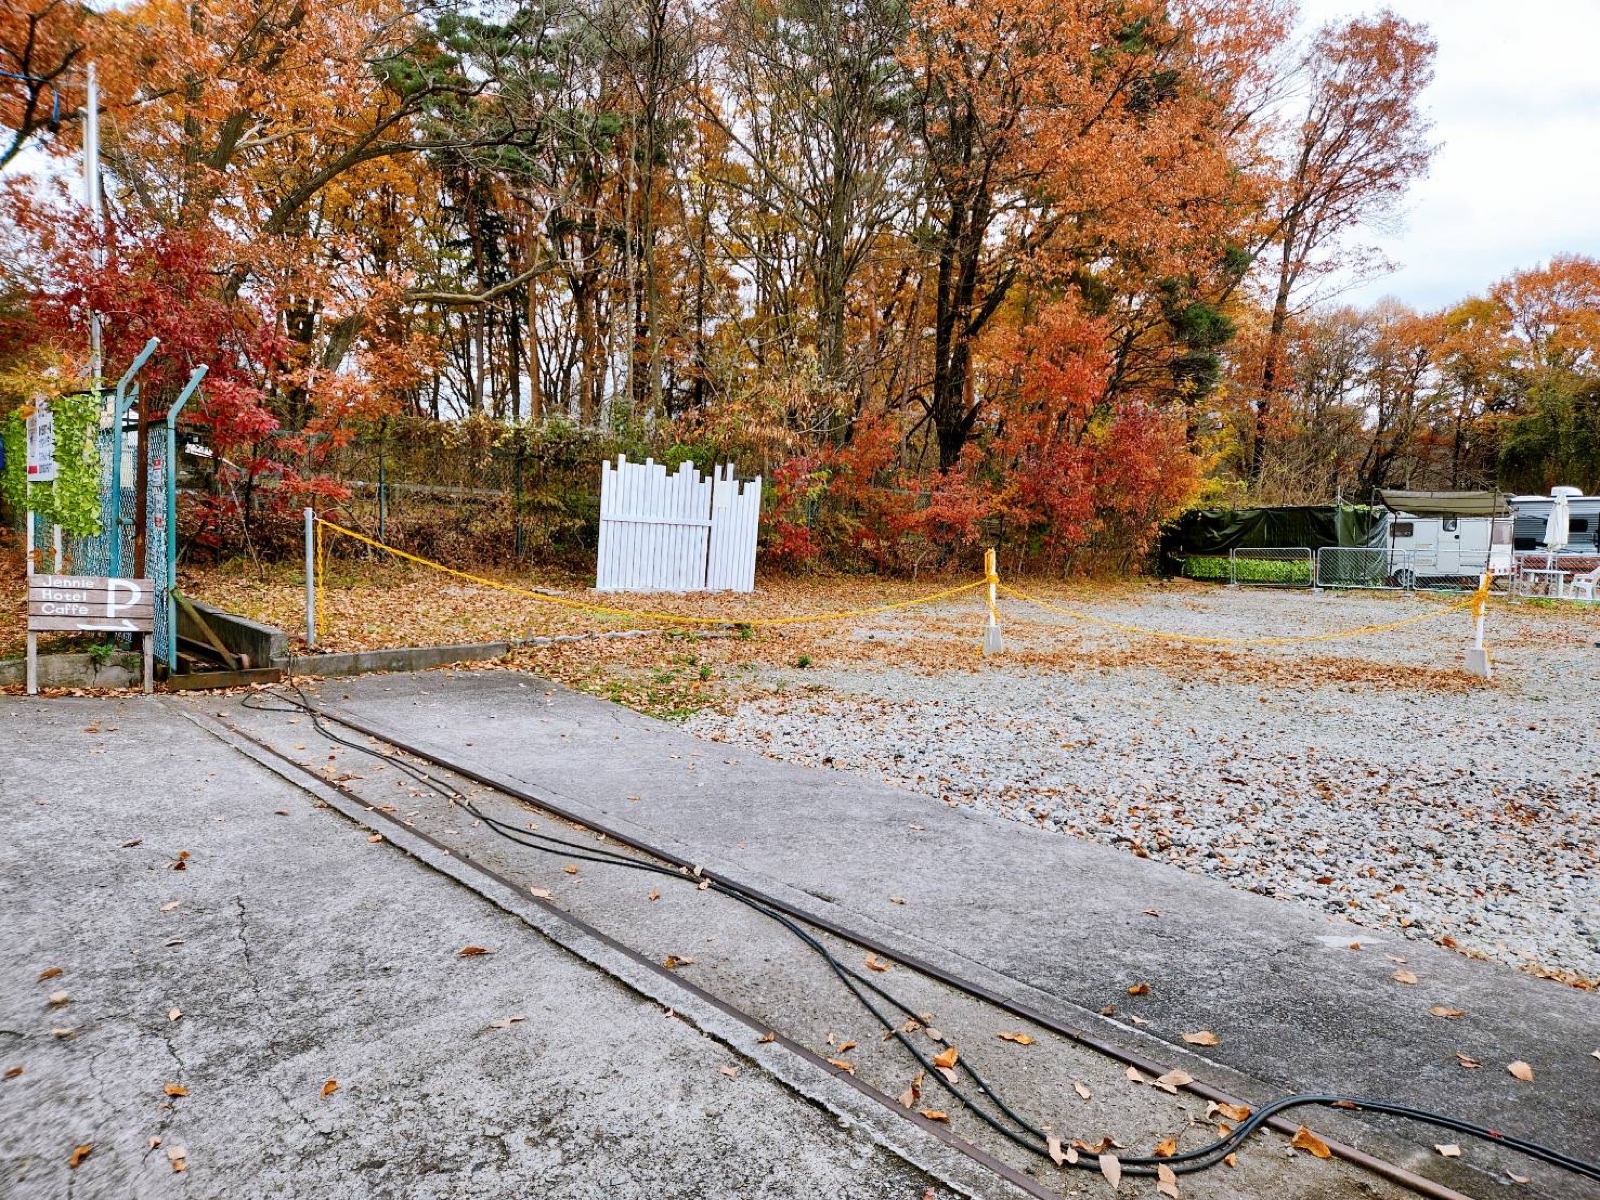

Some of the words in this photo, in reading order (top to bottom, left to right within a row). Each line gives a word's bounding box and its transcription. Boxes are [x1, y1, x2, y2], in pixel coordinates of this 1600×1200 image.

[42, 575, 94, 589] Jennie
[42, 589, 87, 602] Hotel
[107, 578, 142, 618] P
[41, 603, 89, 615] Caffe
